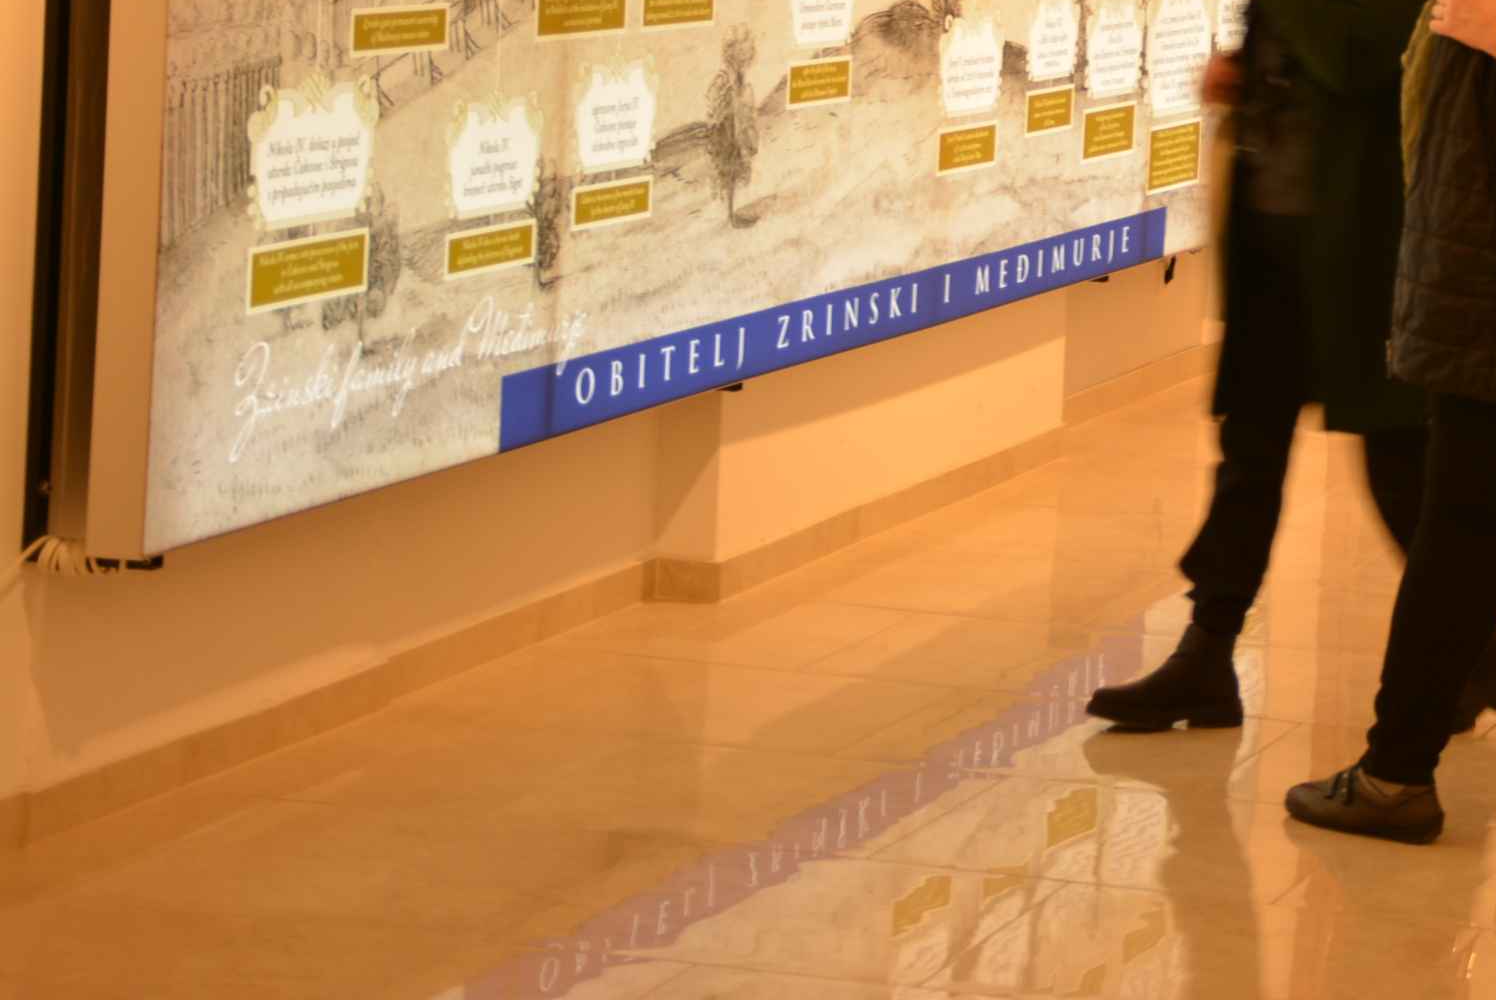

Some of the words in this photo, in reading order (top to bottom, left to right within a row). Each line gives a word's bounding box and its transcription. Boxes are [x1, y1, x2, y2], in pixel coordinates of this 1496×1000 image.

[420, 338, 464, 377] and
[575, 326, 747, 406] OBITELJ
[776, 286, 919, 350] ZRINSKI
[943, 273, 951, 304] I
[974, 225, 1131, 296] MEĐIMURJE
